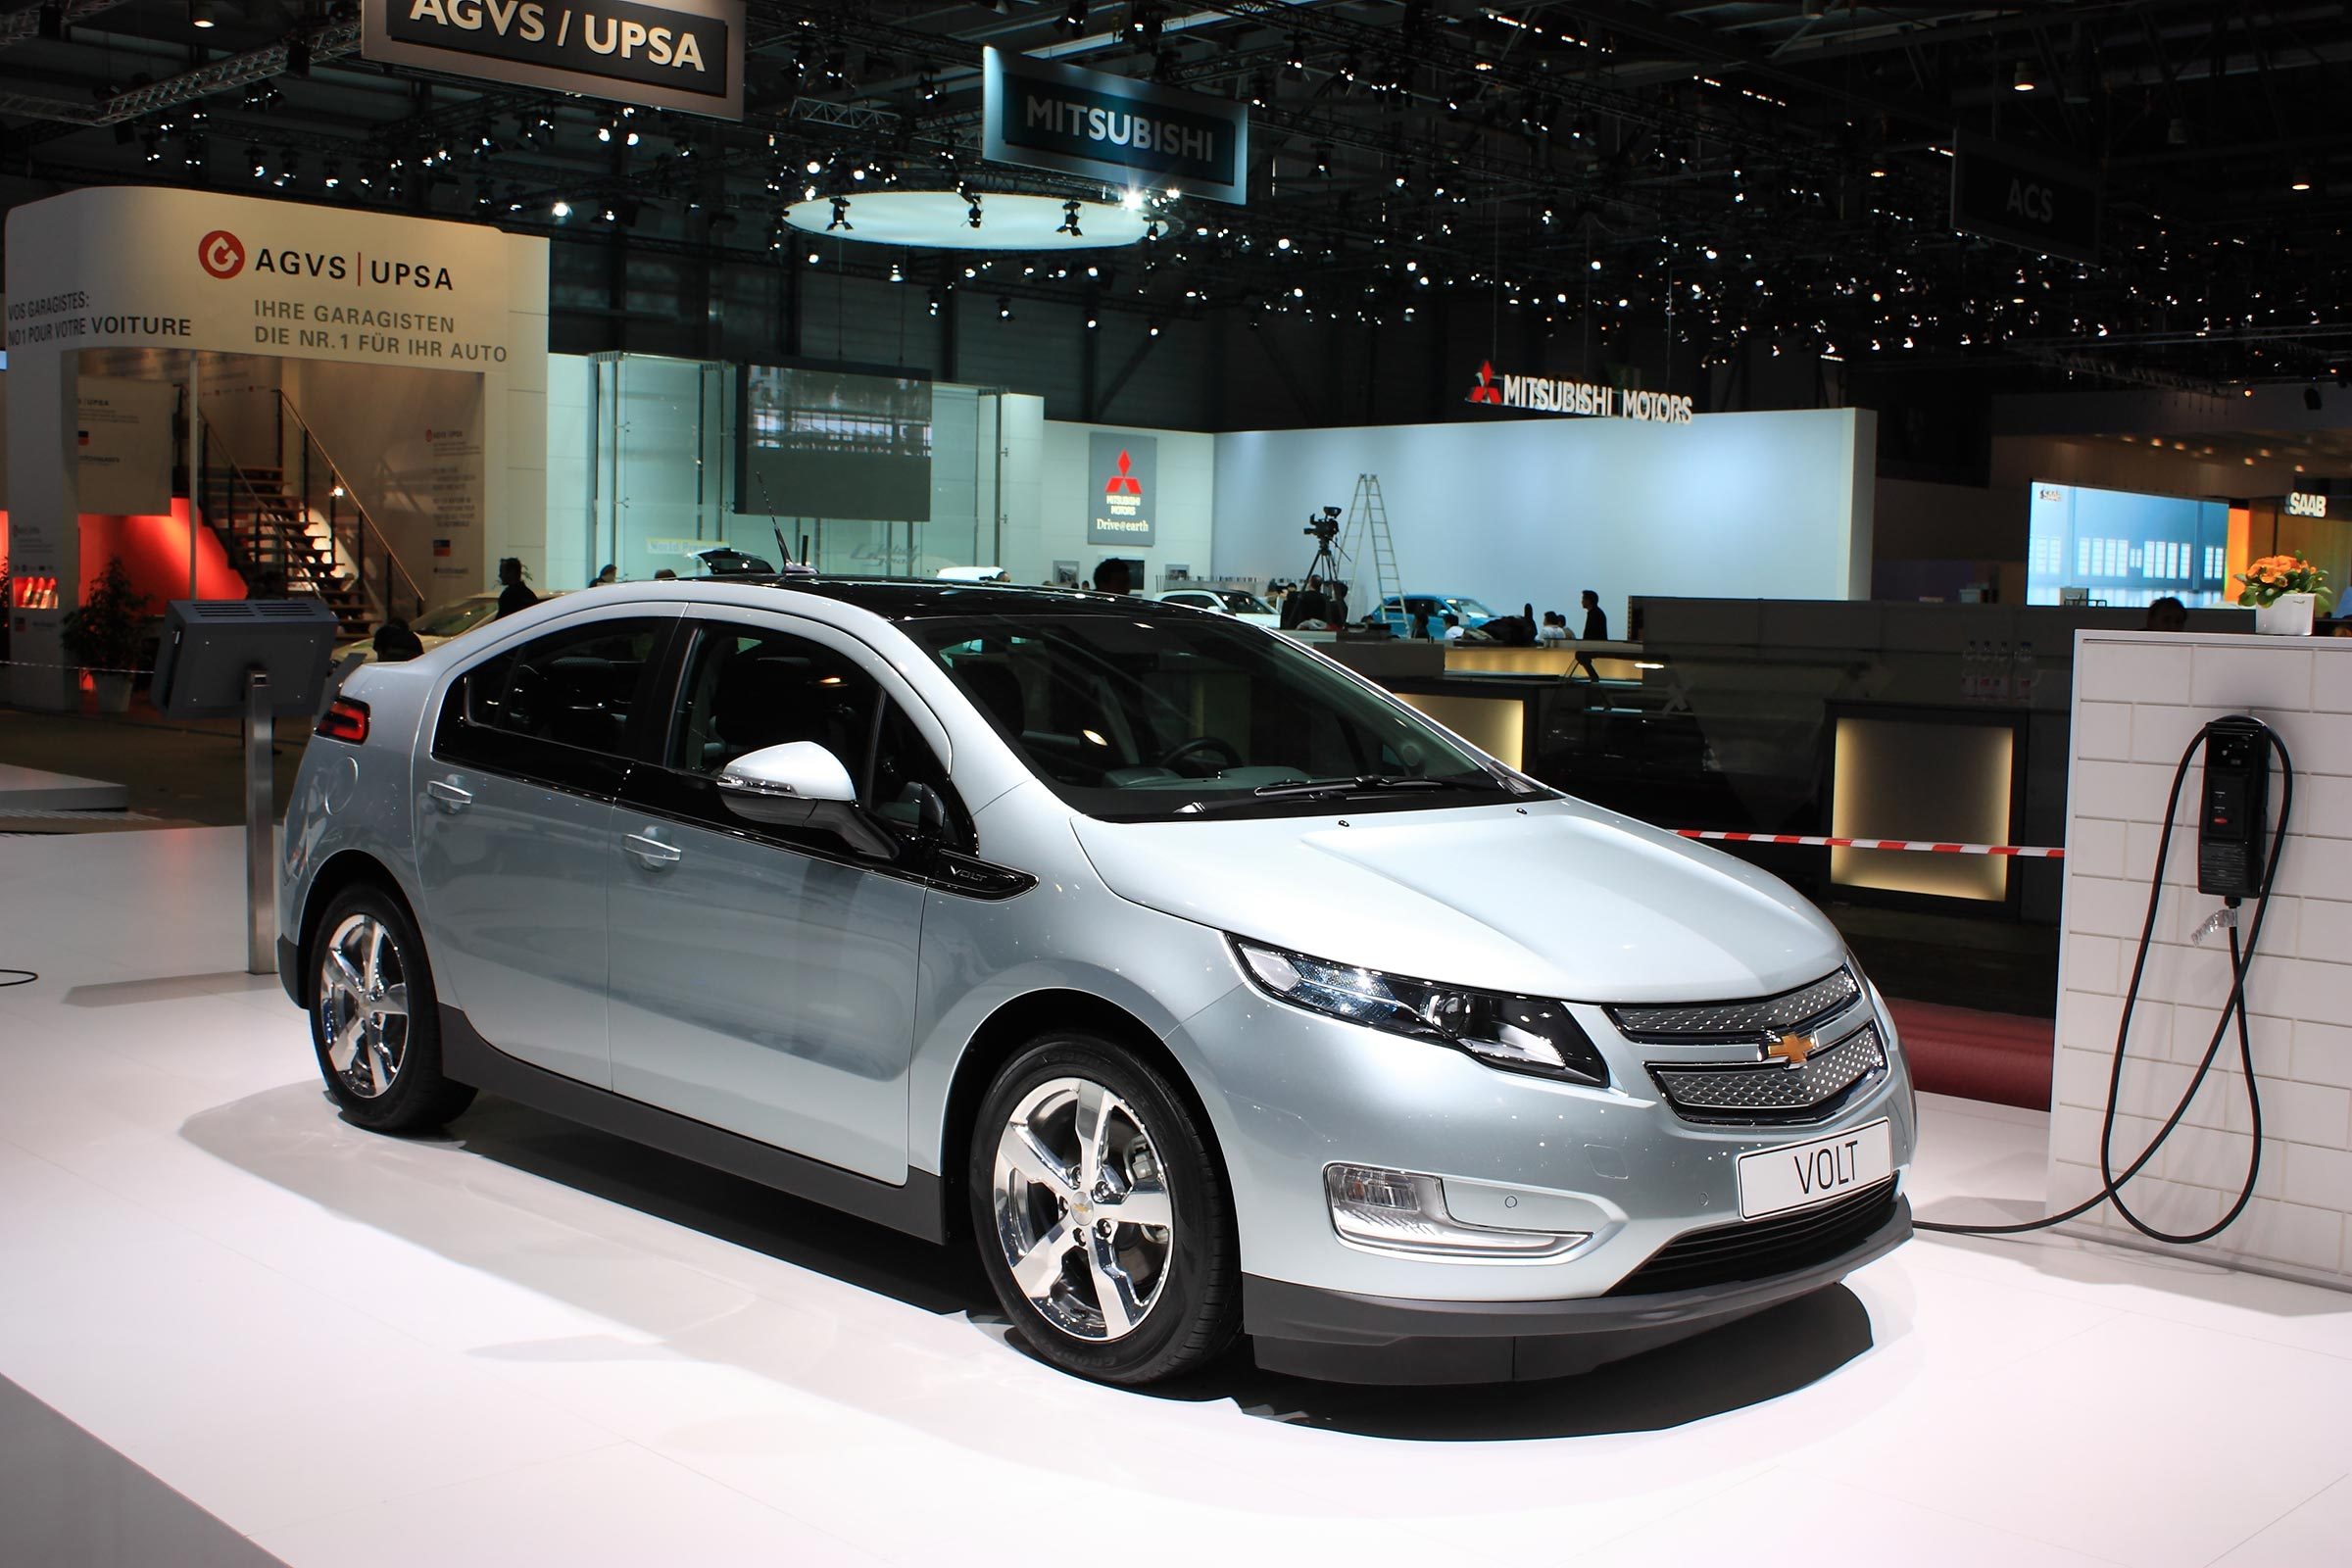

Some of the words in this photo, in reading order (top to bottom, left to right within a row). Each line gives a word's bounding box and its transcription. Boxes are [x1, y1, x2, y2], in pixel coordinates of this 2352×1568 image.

[410, 0, 545, 42] AGVS
[585, 14, 705, 72] UPSA
[1026, 95, 1213, 163] MITSUBISHI
[2007, 177, 2053, 223] ACS
[255, 248, 346, 280] AGVS
[371, 260, 454, 291] UPSA
[8, 303, 25, 321] VOS
[27, 291, 90, 318] GARAGISTES:
[254, 299, 305, 320] IHRE
[314, 305, 455, 334] GARAGISTEN
[28, 323, 53, 343] POUR
[55, 318, 86, 339] VOTRE
[91, 316, 191, 337] VOITURE
[255, 325, 290, 345] DIE
[359, 332, 400, 355] FÜR
[408, 339, 442, 358] IHR
[451, 343, 508, 363] AUTO
[1503, 374, 1613, 417] MITSUBISHI
[1622, 388, 1693, 425] MOTORS
[2288, 491, 2327, 517] SAAB
[1097, 518, 1149, 532] Drive@earth
[950, 864, 988, 882] VOLT
[1793, 1140, 1858, 1195] VOLT
